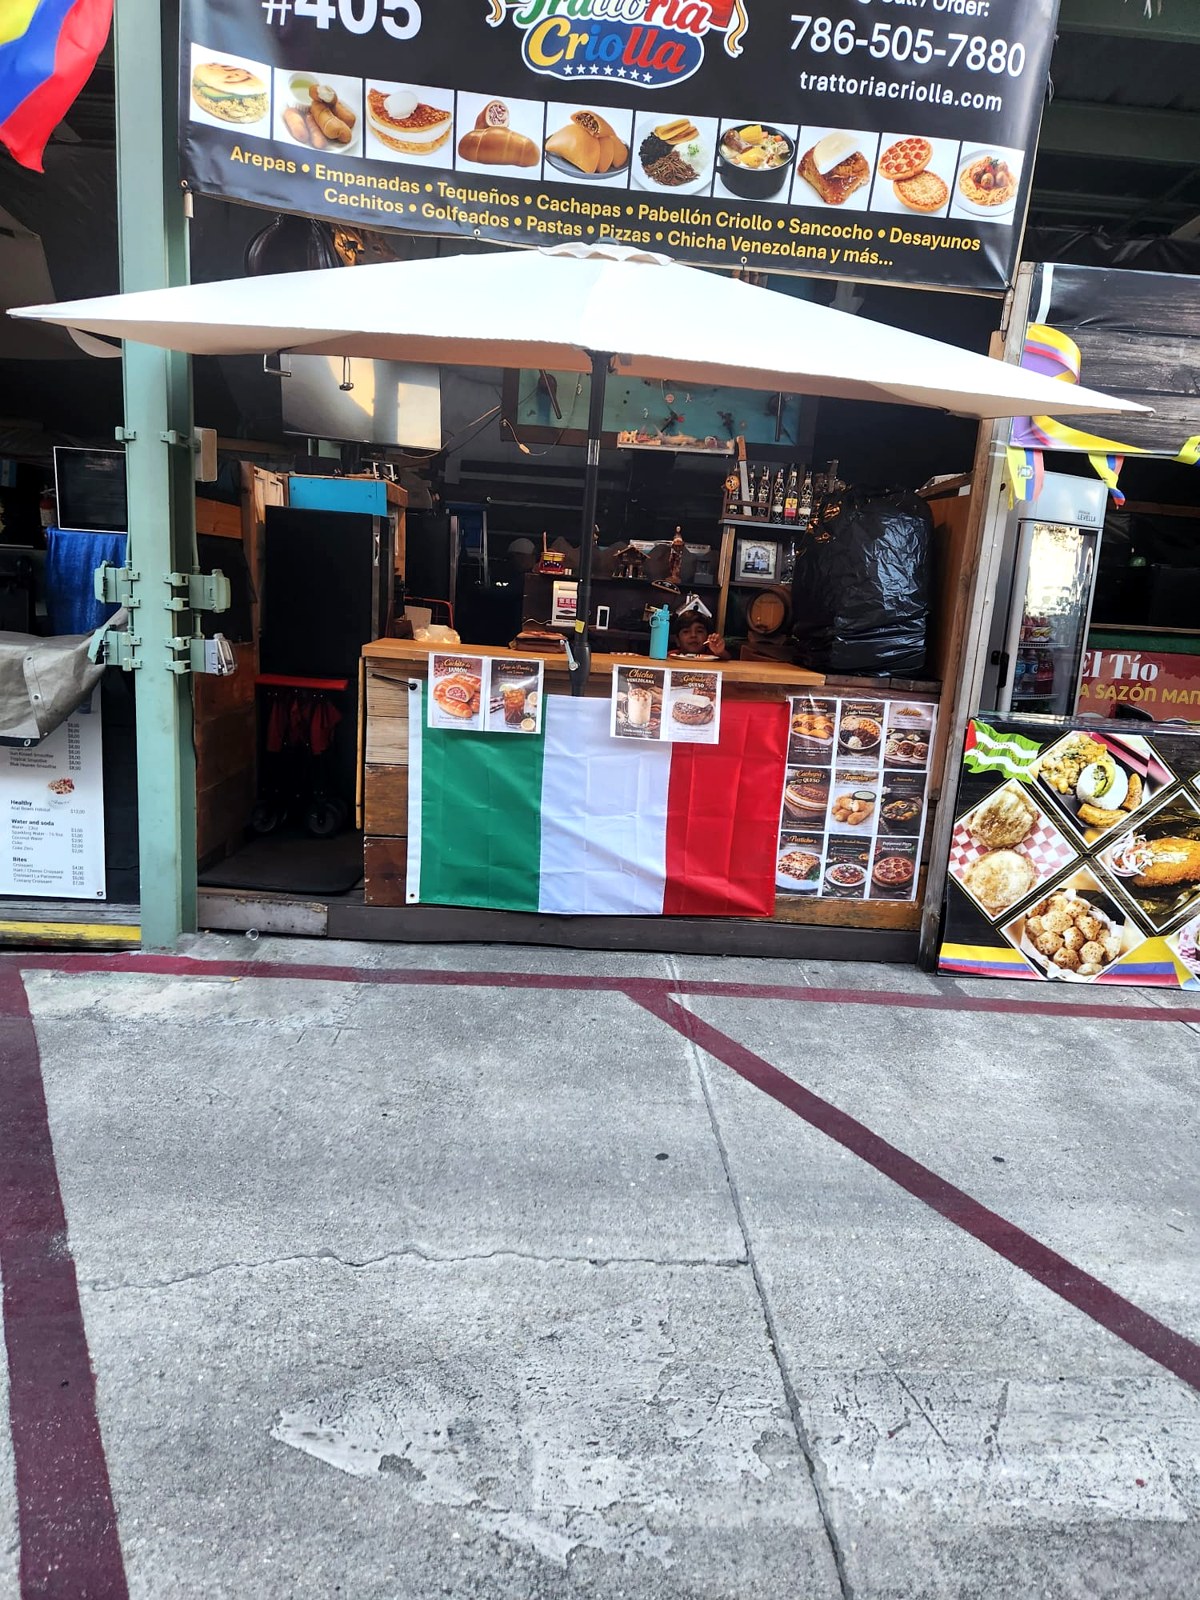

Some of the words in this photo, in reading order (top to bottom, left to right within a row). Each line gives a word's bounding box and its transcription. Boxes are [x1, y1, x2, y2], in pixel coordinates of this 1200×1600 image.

[528, 16, 687, 74] Criolla
[790, 14, 1026, 78] 786-505-7880
[800, 71, 1002, 112] trattoriacriolla.com
[230, 145, 297, 174] Arepas
[315, 164, 420, 194] Empanadas
[437, 181, 520, 207] Tequeños
[536, 194, 621, 219] Cachapas
[638, 204, 712, 226] Pabellón
[715, 211, 773, 232] Criollo
[789, 217, 874, 241] Sancocho
[889, 227, 981, 252] Desayunos
[324, 188, 404, 214] Cachitos
[421, 203, 510, 229] Golfeados
[526, 215, 583, 237] Pastas
[599, 223, 651, 243] Pizzas
[667, 230, 727, 251] Chicha
[731, 235, 827, 259] Venezolana
[829, 248, 841, 264] y
[843, 247, 894, 266] más...
[626, 677, 655, 685] VENEZOLANA
[628, 668, 654, 679] Chicha
[1109, 654, 1159, 682] Tío
[11, 799, 32, 807] Healthy
